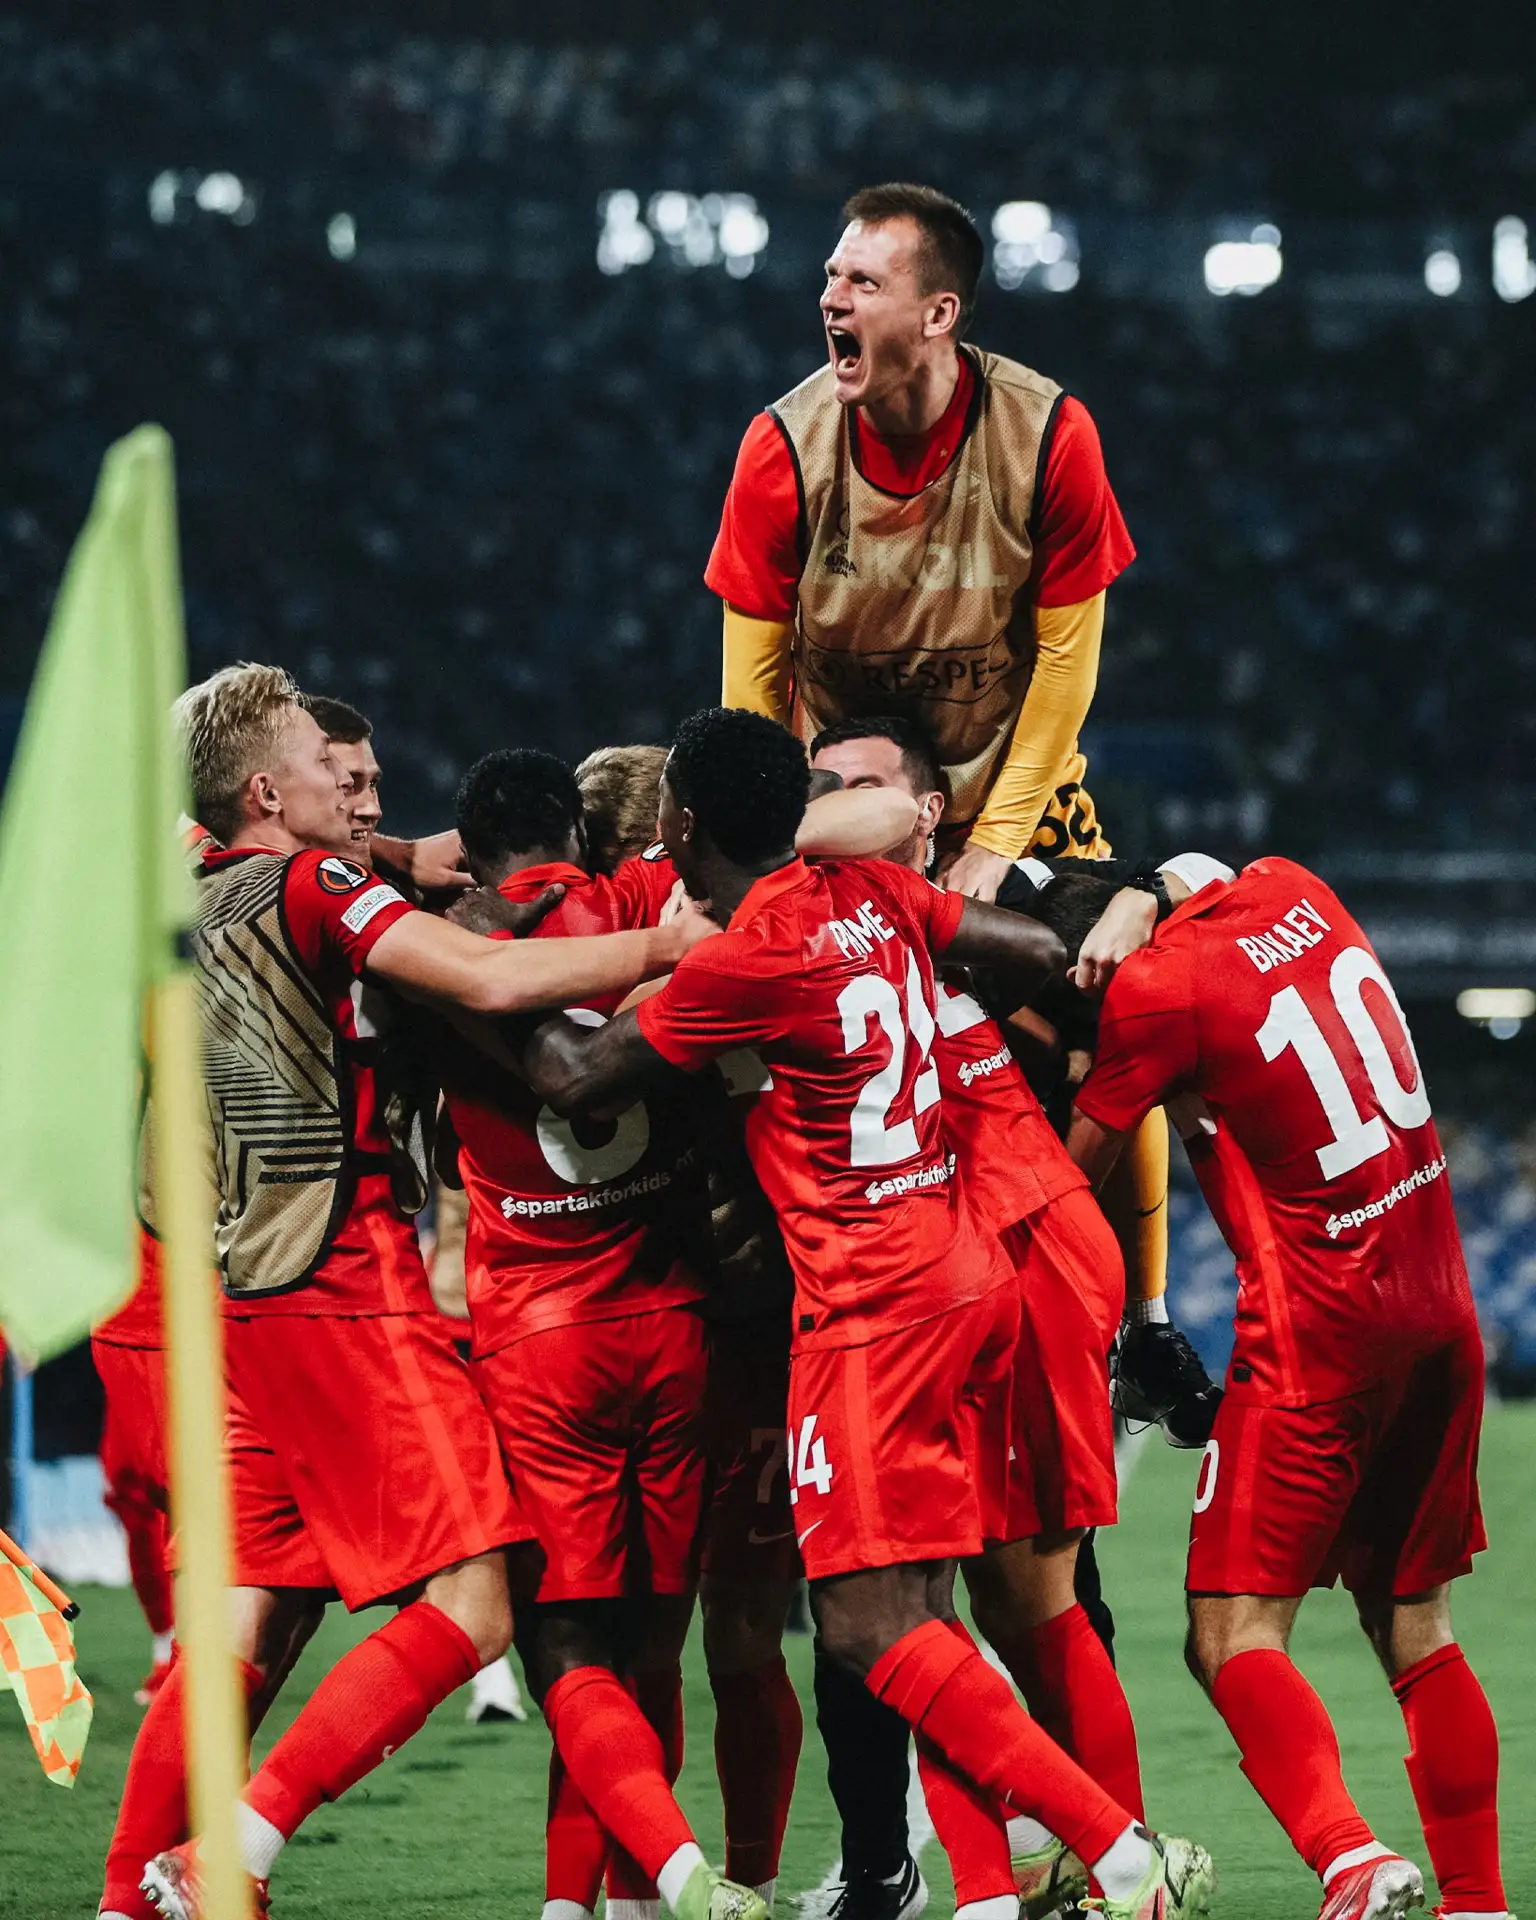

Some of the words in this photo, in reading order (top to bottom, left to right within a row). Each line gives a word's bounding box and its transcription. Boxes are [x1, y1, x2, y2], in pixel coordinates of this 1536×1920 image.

[861, 657, 1008, 691] RESPE
[1235, 898, 1332, 974] BAKAEV
[1254, 946, 1432, 1181] 10
